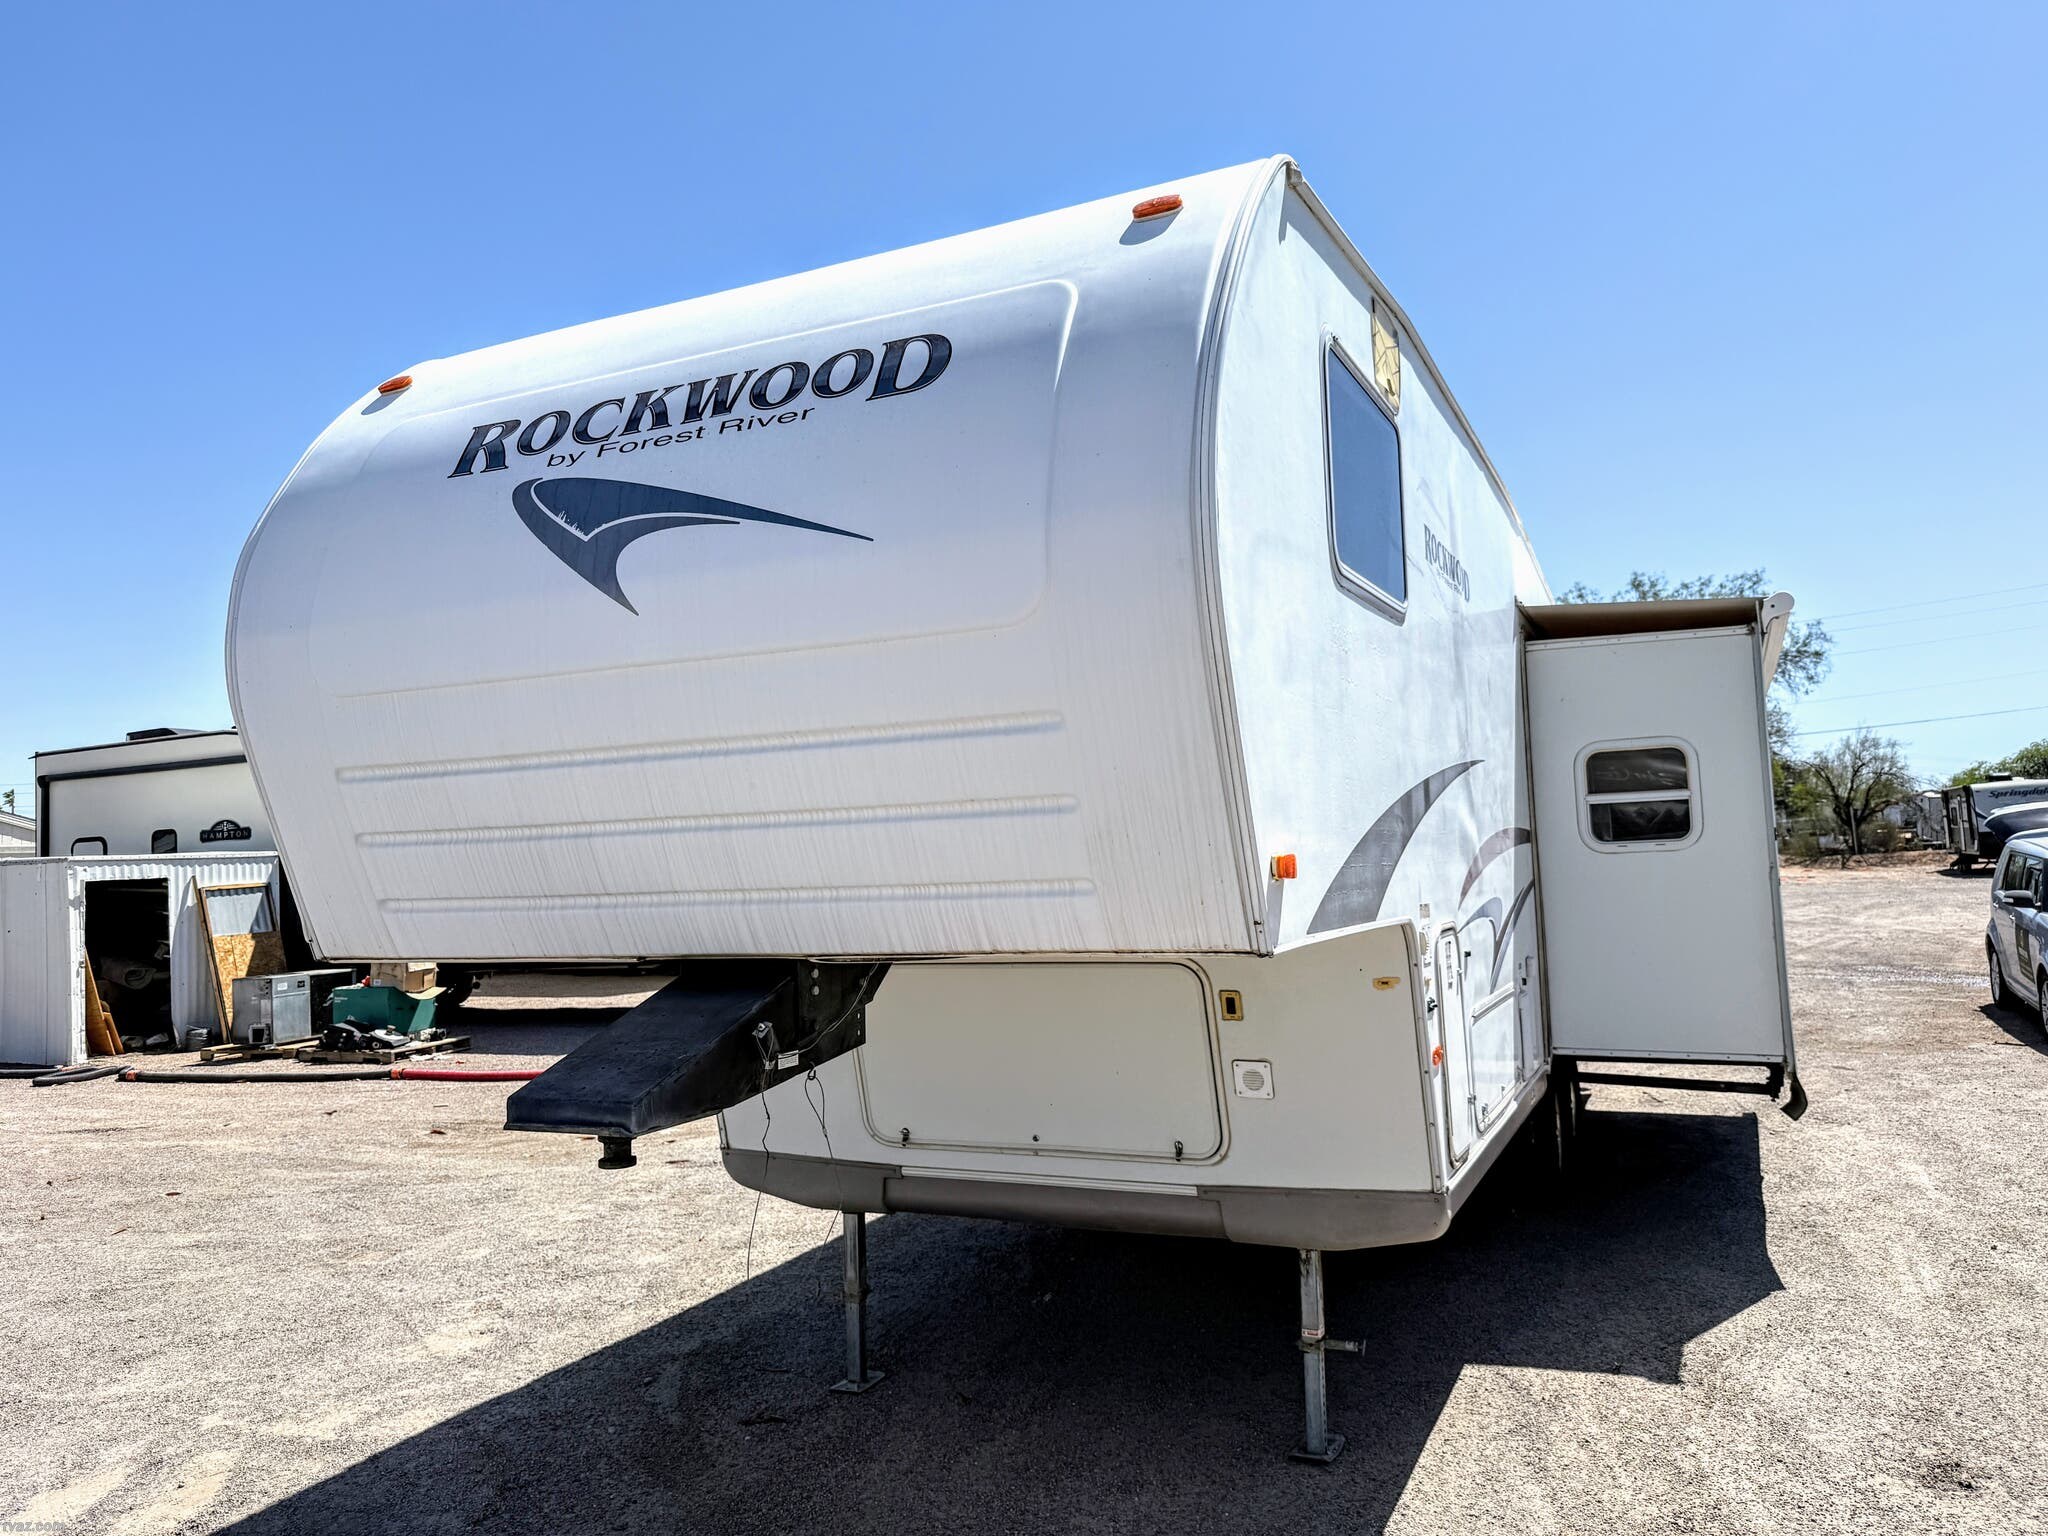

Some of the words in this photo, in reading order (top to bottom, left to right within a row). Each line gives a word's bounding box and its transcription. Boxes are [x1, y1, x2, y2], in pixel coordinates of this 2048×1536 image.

[447, 333, 952, 478] ROCKWOOD
[546, 452, 586, 468] by
[597, 427, 706, 457] Forest
[719, 406, 815, 434] River
[1988, 787, 2048, 799] Springdal
[202, 830, 249, 841] HAMPTON
